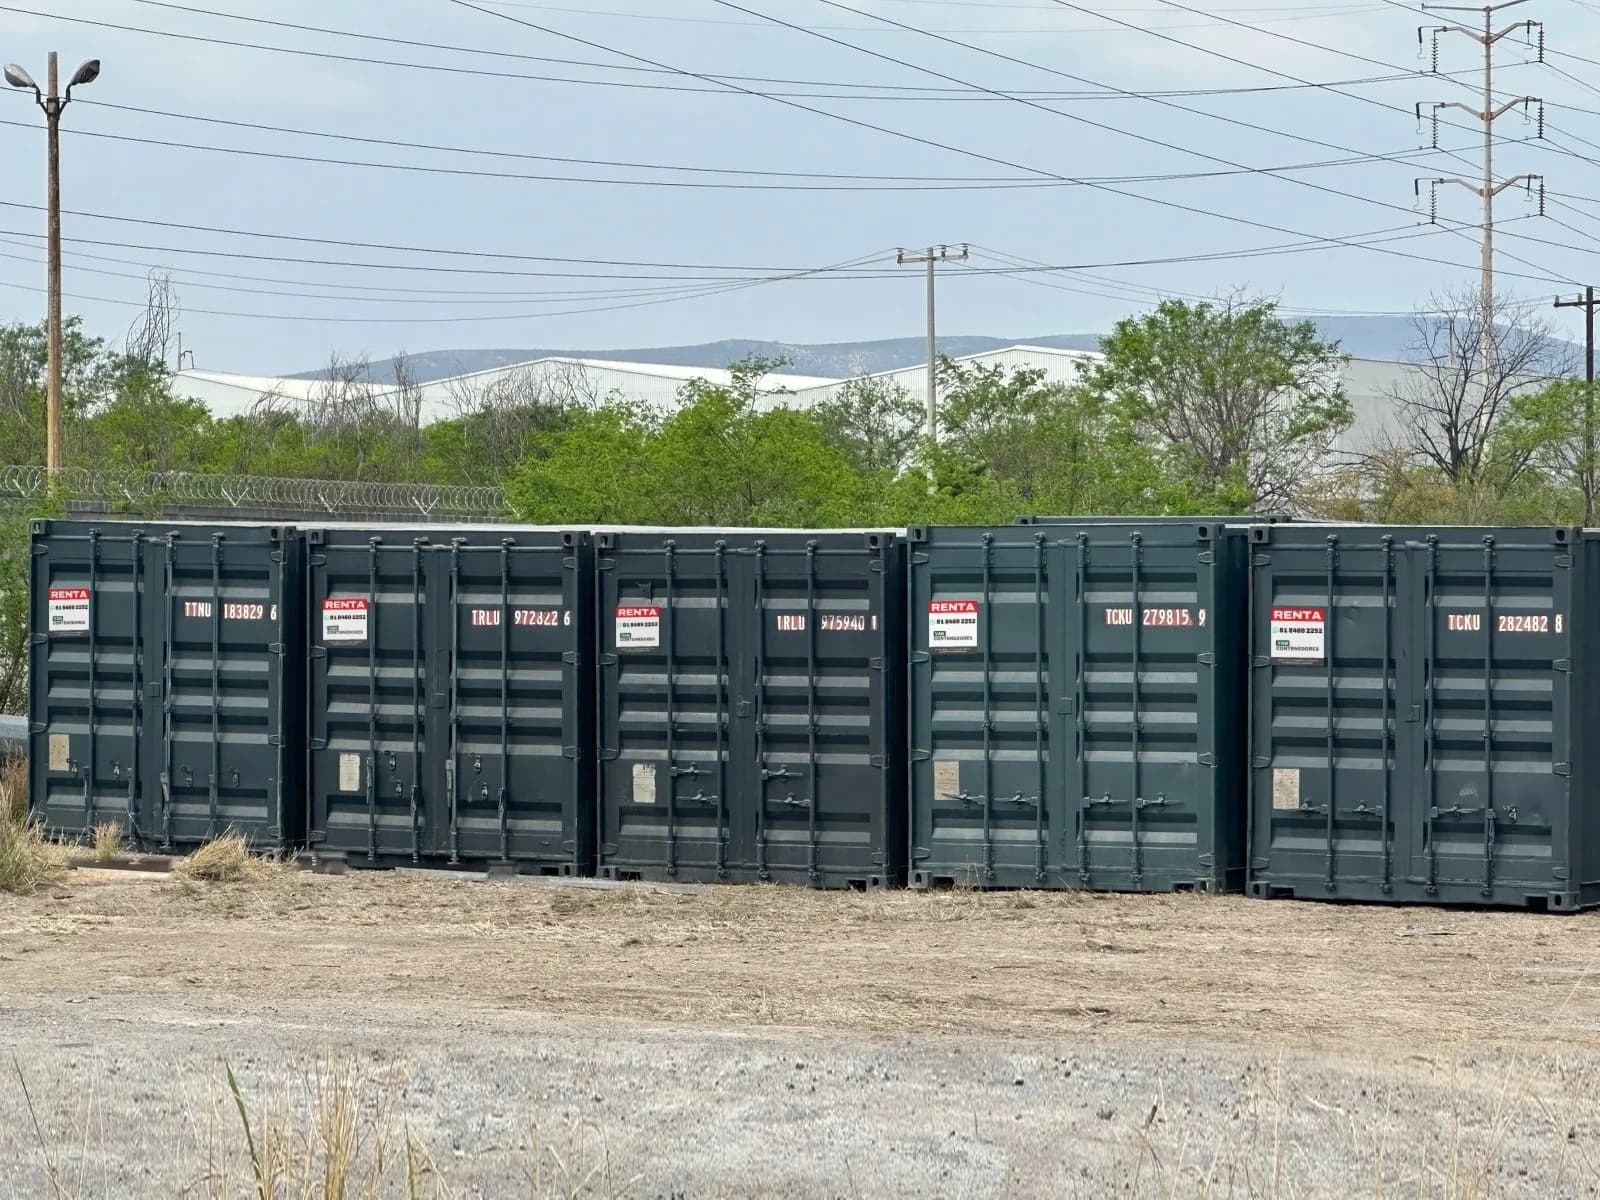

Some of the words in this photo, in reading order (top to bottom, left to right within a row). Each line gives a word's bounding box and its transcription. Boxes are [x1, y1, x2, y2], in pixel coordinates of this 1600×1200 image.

[51, 590, 88, 598] RENTA
[184, 601, 212, 618] TTNU
[224, 603, 264, 620] 183829
[270, 604, 278, 620] 6
[325, 601, 365, 609] RENTA
[931, 603, 975, 611] RENTA
[471, 609, 501, 626] TRLU
[514, 610, 559, 626] 972822
[563, 610, 571, 626] 6
[618, 608, 657, 616] RENTA
[1105, 608, 1133, 625] TCKU
[1142, 608, 1189, 626] 279815
[1198, 608, 1206, 626] 9
[1274, 610, 1322, 619] RENTA
[821, 615, 865, 631] 975940
[1448, 614, 1480, 631] TCKU
[1499, 615, 1548, 632] 282482
[1555, 614, 1563, 633] 8
